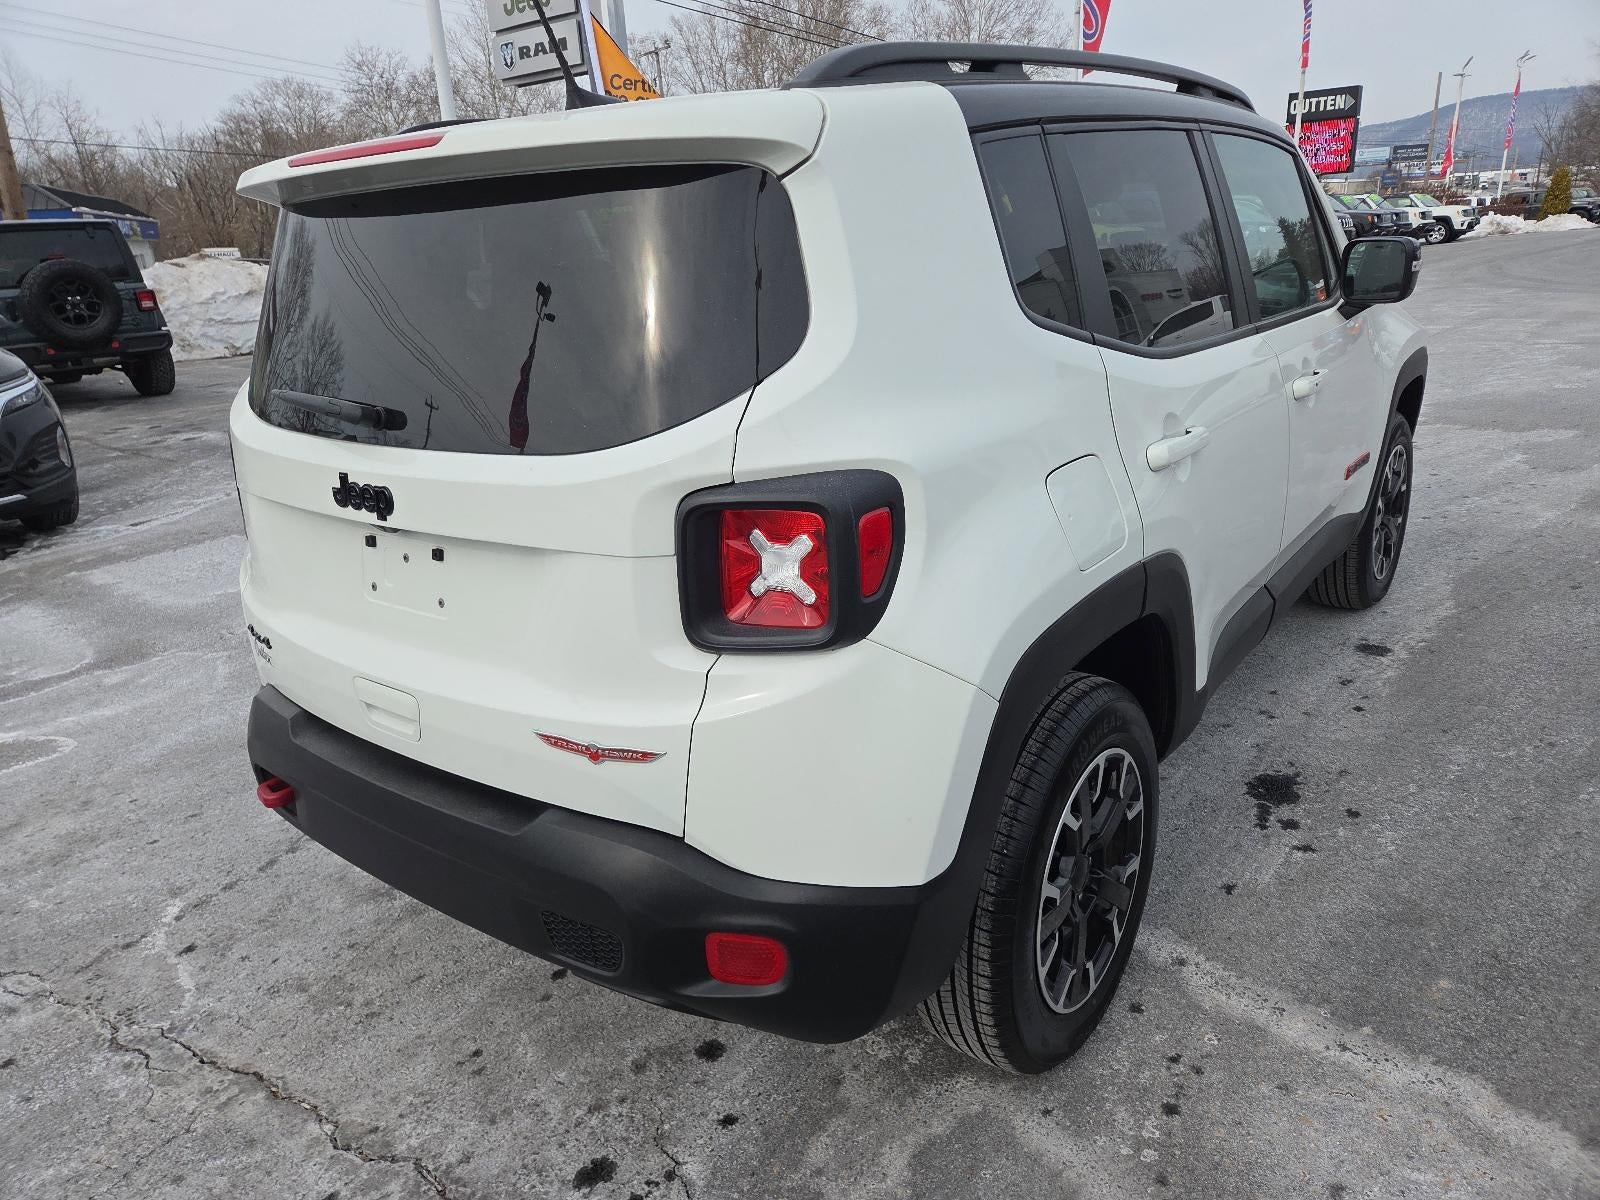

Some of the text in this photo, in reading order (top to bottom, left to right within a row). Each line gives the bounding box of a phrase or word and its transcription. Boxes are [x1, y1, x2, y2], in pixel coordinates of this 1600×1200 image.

[518, 37, 568, 60] RAM
[1290, 94, 1346, 114] OUTTEN
[332, 472, 395, 521] Jeep
